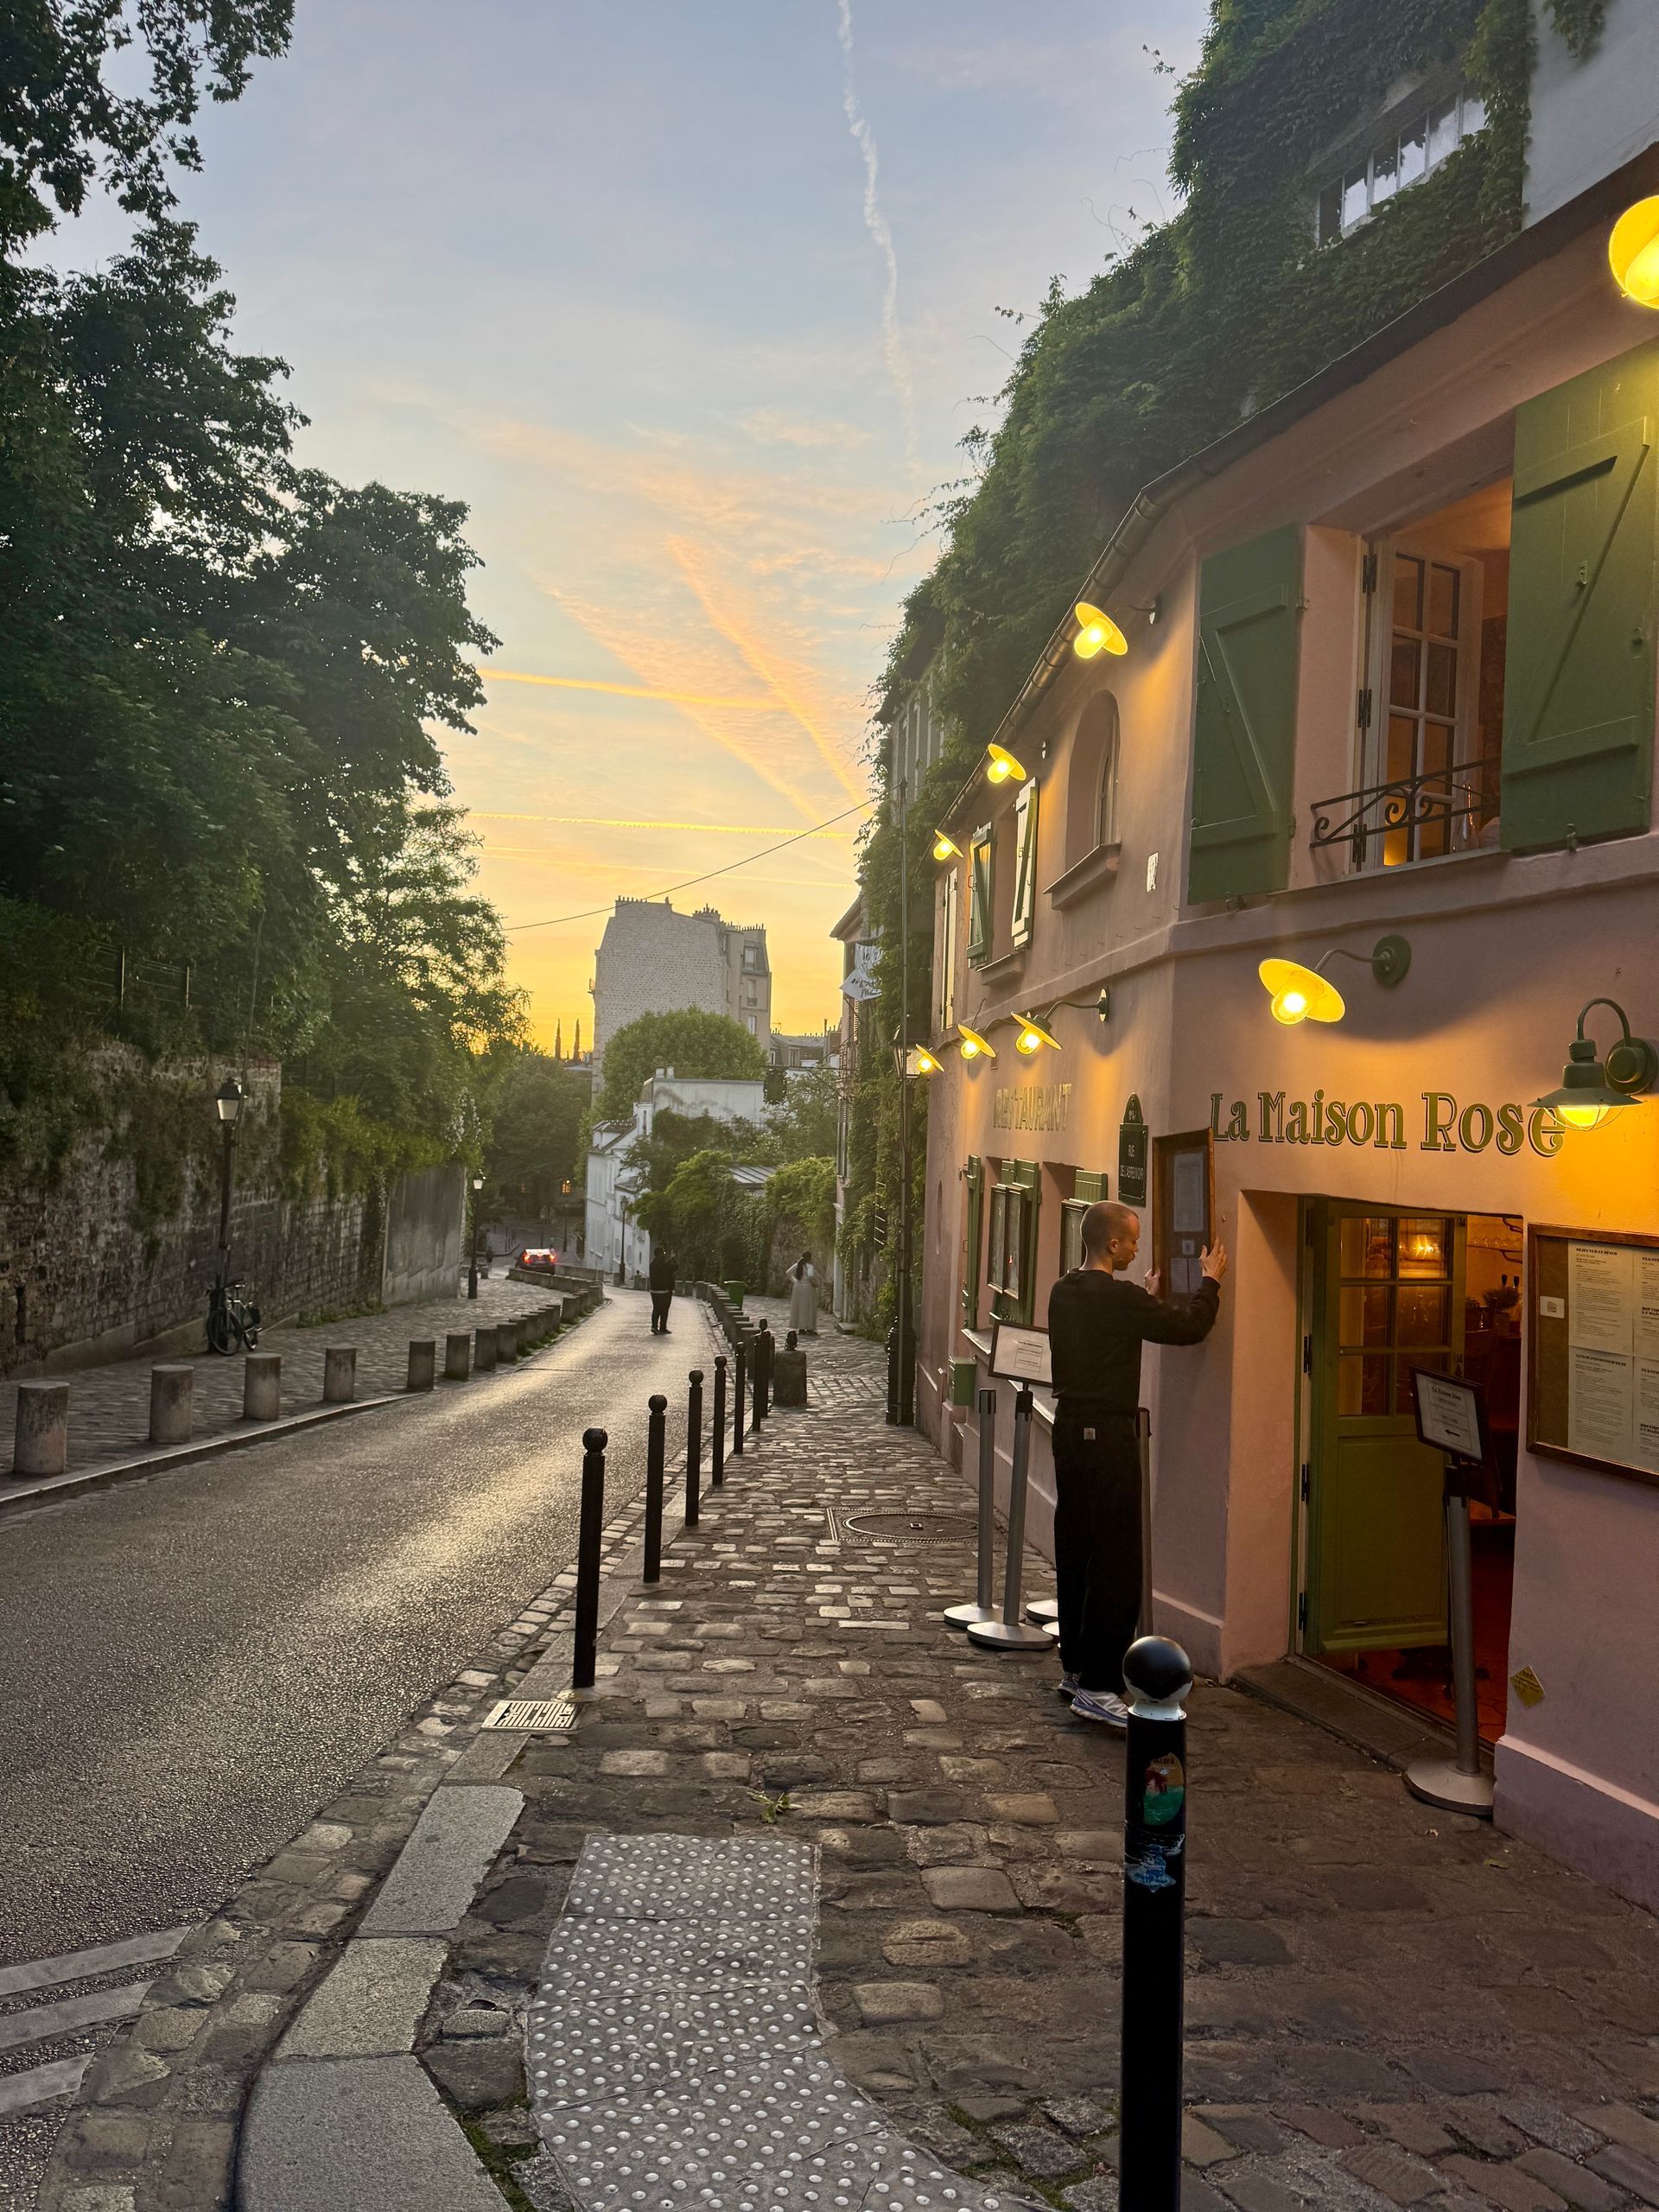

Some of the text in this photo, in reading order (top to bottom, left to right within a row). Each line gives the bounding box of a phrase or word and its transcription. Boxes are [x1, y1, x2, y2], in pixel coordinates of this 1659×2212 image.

[994, 1083, 1072, 1131] RESTAURANT
[1211, 1089, 1567, 1158] La Maison Rose
